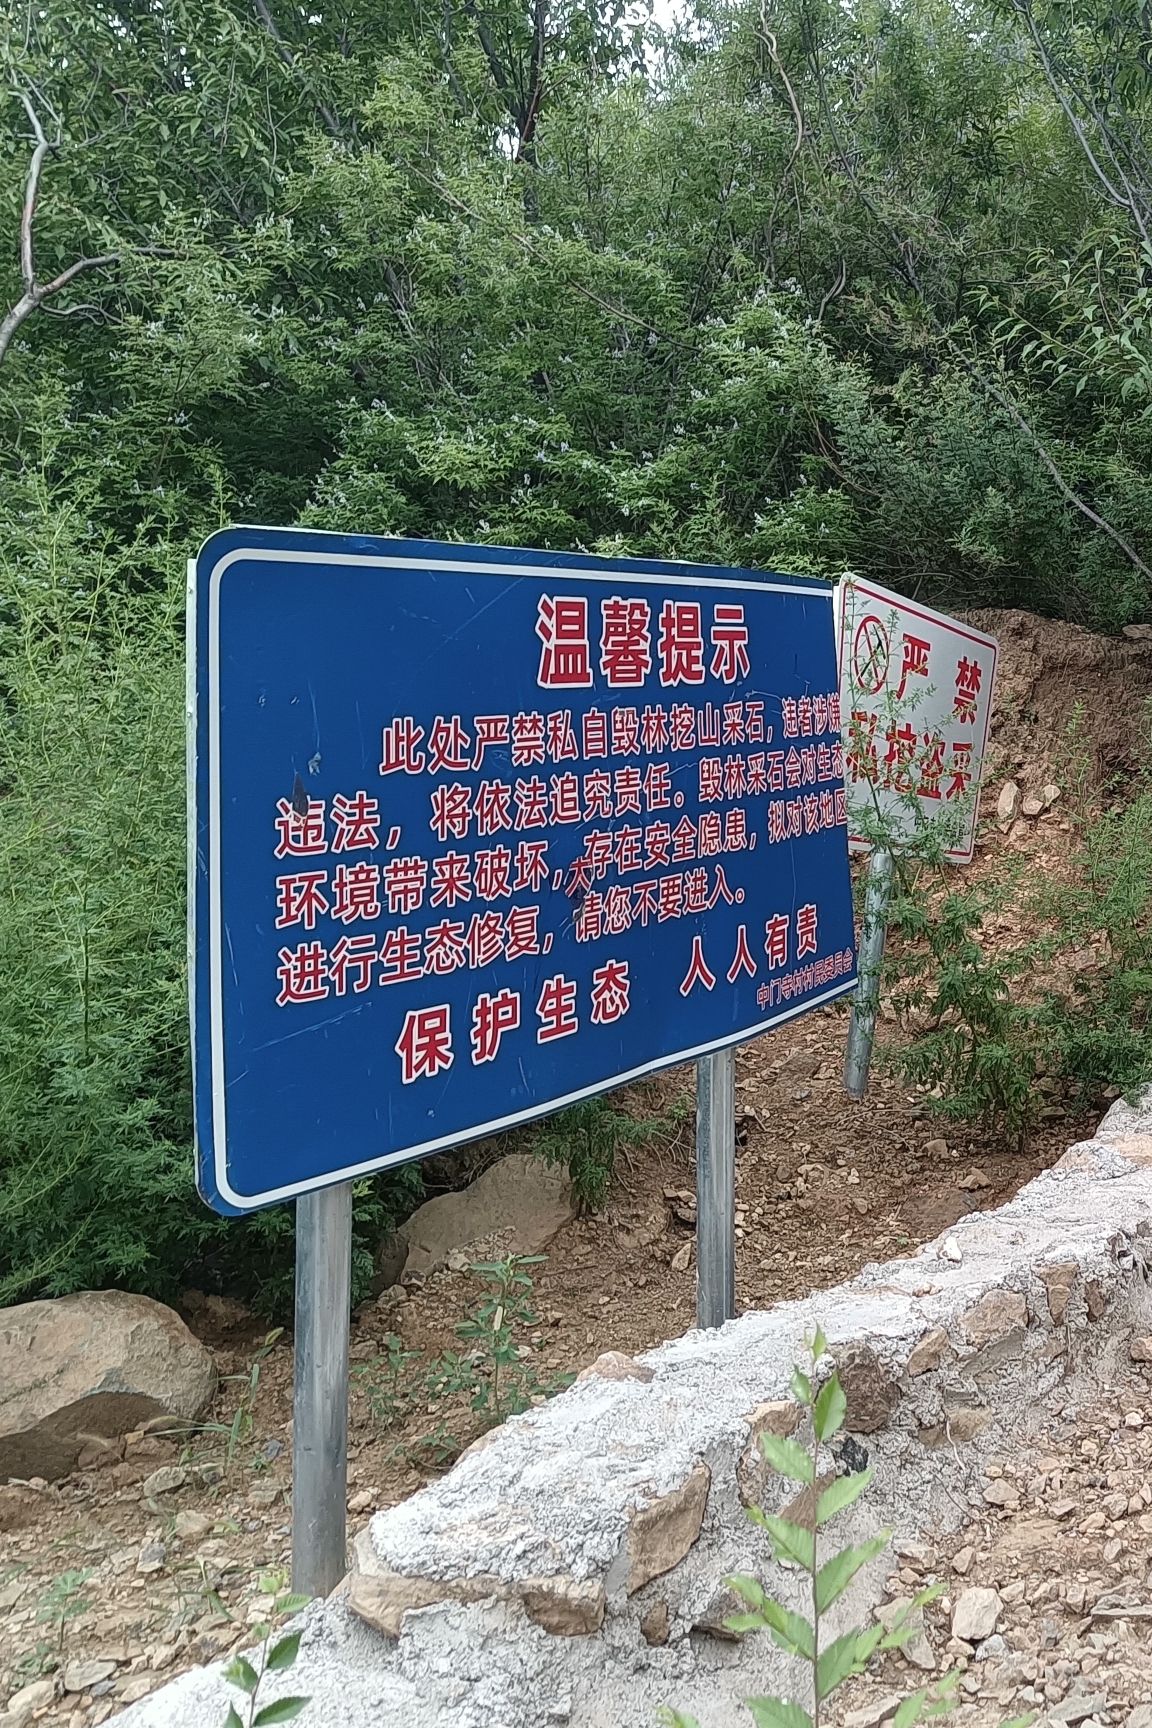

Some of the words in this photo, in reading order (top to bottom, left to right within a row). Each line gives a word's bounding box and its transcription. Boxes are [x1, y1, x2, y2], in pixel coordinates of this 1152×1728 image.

[535, 594, 751, 688] 温馨提示
[394, 958, 630, 1084] 保护生态
[680, 904, 817, 997] 人人有责
